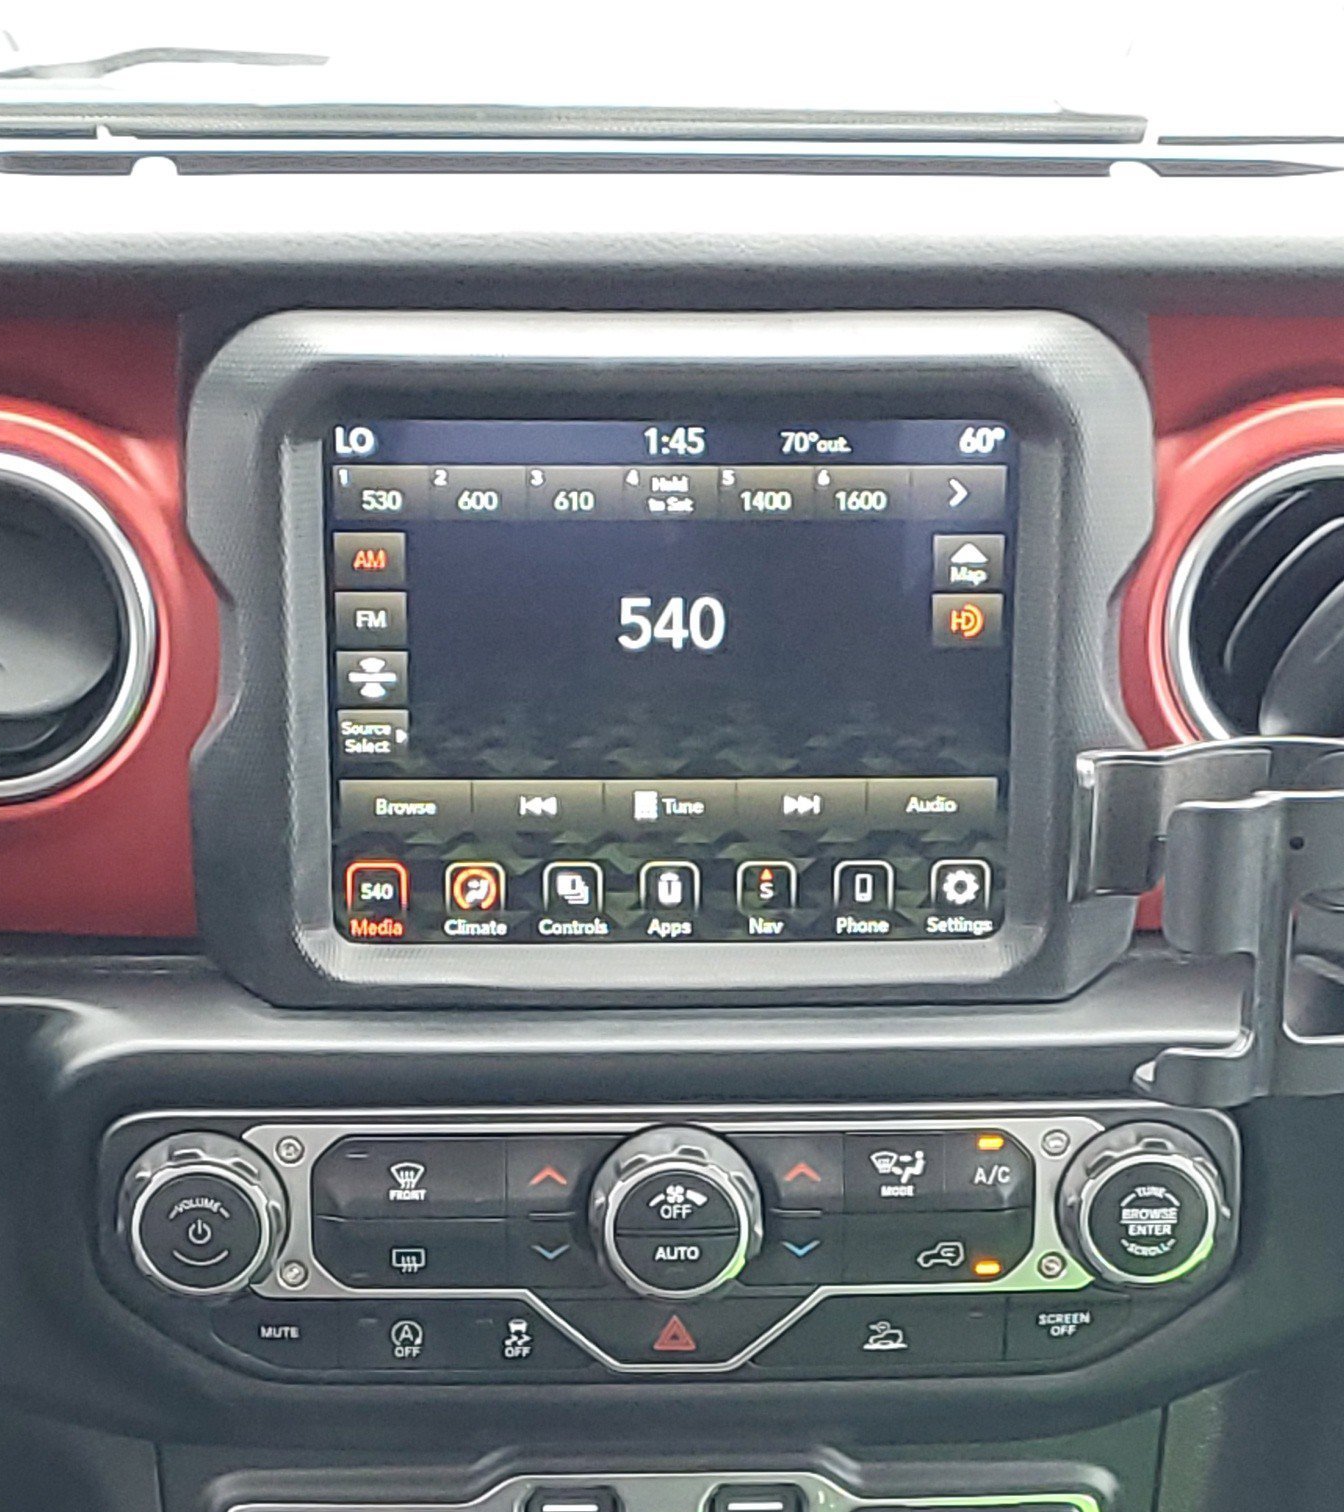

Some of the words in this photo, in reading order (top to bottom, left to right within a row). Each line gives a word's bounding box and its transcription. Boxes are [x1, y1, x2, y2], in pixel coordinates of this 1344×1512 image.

[334, 427, 376, 455] LO
[644, 428, 704, 454] 1:45
[338, 470, 348, 486] 1
[434, 470, 447, 486] 2
[530, 471, 543, 486] 3
[626, 470, 639, 486] 4
[722, 470, 735, 486] 5
[817, 470, 830, 486] 6
[362, 491, 402, 511] 530
[457, 491, 498, 511] 600
[554, 491, 594, 511] 610
[741, 491, 791, 511] 1400
[836, 491, 886, 511] 1600
[353, 551, 386, 569] AM
[356, 611, 387, 629] FM
[618, 596, 725, 650] 540
[342, 721, 390, 736] Source
[345, 739, 390, 754] Select
[375, 799, 436, 815] Browse
[661, 799, 704, 815] Tune
[906, 796, 956, 813] Audio
[350, 919, 402, 936] Media
[445, 919, 506, 937] Climate
[539, 919, 608, 937] Controls
[648, 919, 691, 937] Apps
[749, 919, 782, 935] Nav
[835, 917, 889, 934] Phone
[927, 916, 991, 935] Settings
[974, 1164, 1011, 1186] A/C
[389, 1189, 426, 1202] FRONT
[881, 1186, 914, 1197] MODE
[176, 1198, 221, 1212] VOLUME
[660, 1204, 692, 1219] OFF
[1122, 1207, 1178, 1220] BROWSE
[1128, 1224, 1172, 1236] ENTER
[656, 1245, 699, 1261] AUTO
[1038, 1312, 1089, 1325] SCREEN
[261, 1326, 299, 1338] MUTE
[1051, 1325, 1076, 1336] OFF
[394, 1346, 420, 1358] OFF
[505, 1346, 532, 1358] OFF
